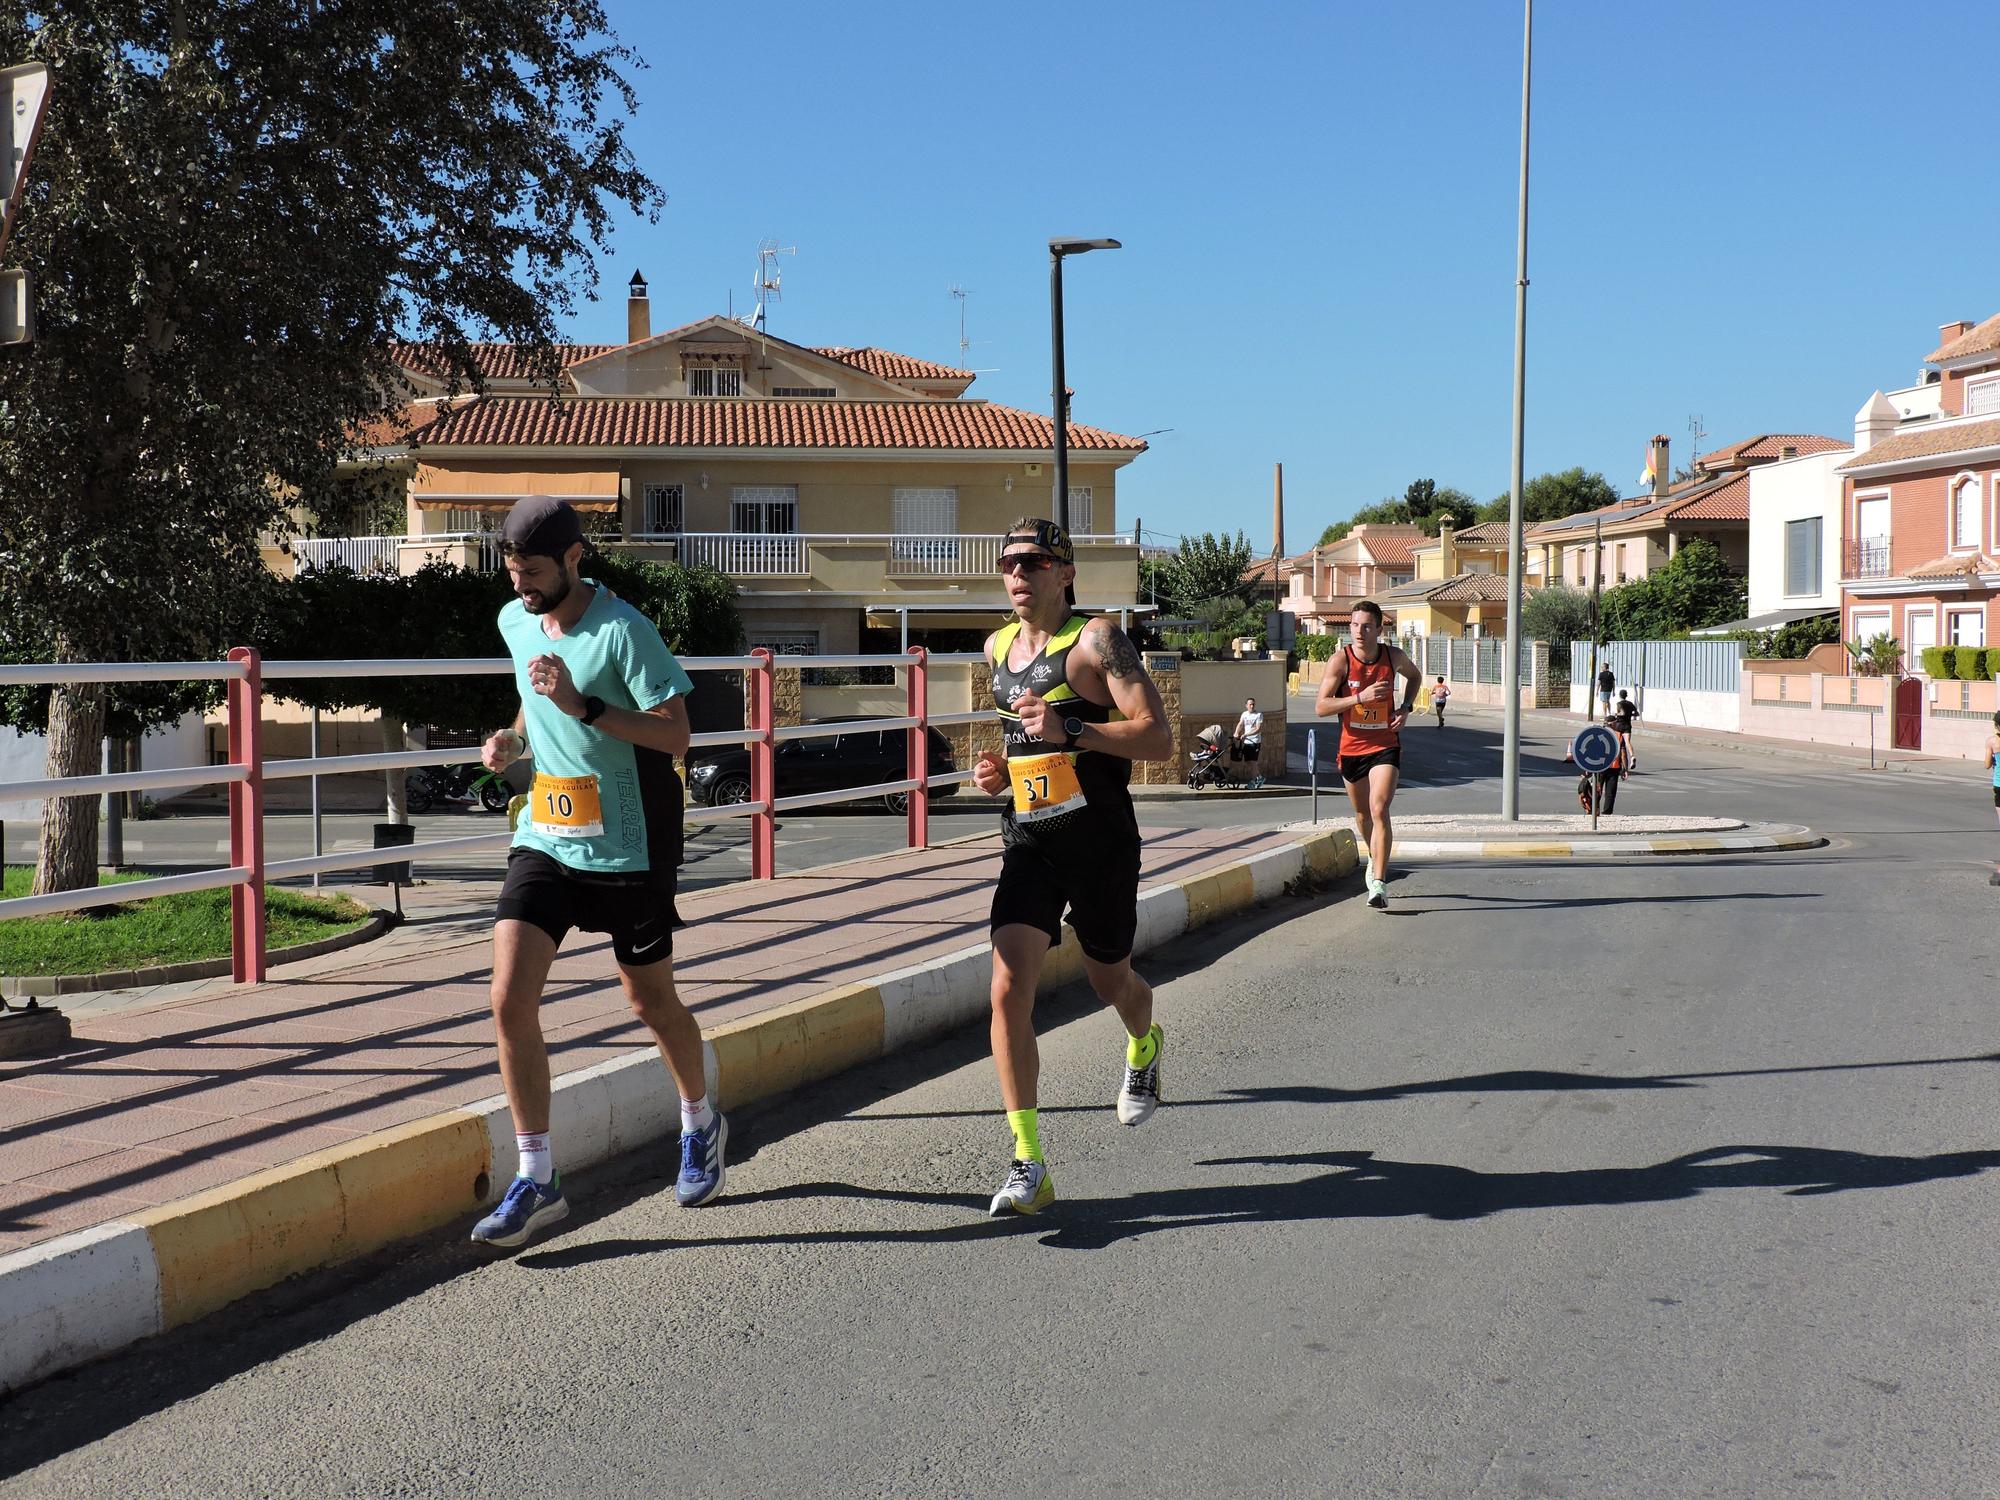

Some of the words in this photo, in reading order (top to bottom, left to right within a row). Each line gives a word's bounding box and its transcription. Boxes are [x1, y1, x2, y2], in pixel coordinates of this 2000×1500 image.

[1363, 710, 1377, 721] 71
[561, 783, 594, 791] ÁGUILAS
[1023, 774, 1048, 802] 37
[546, 792, 573, 817] 10
[614, 768, 642, 854] TERREX
